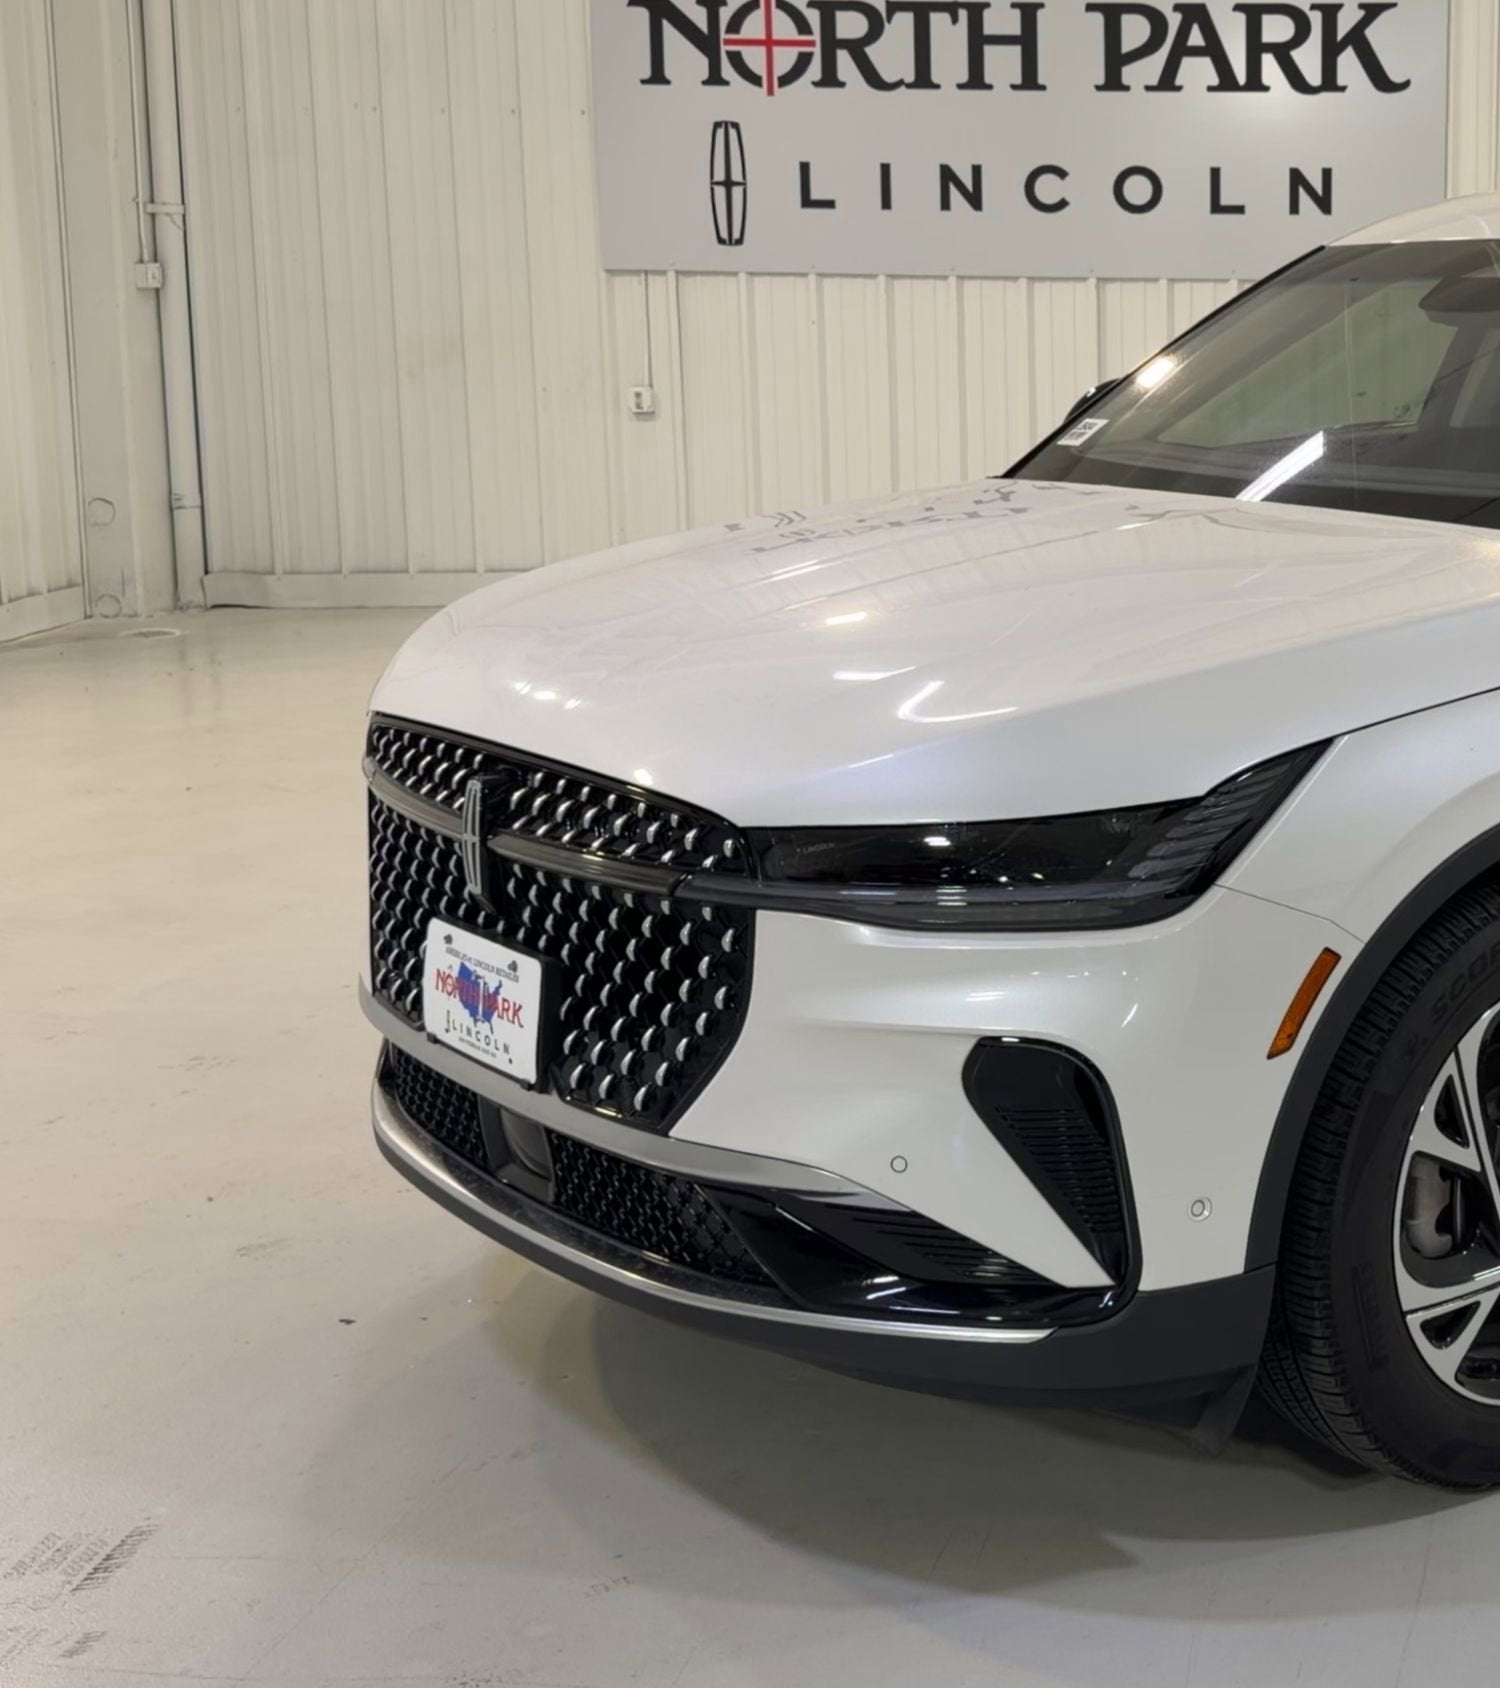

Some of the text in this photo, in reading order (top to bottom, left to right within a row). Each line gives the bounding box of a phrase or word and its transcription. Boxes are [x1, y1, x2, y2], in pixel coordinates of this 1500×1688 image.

[627, 0, 1411, 96] NORTH PARK
[799, 162, 1333, 216] LINCOLN
[452, 1019, 509, 1055] LINCOLN
